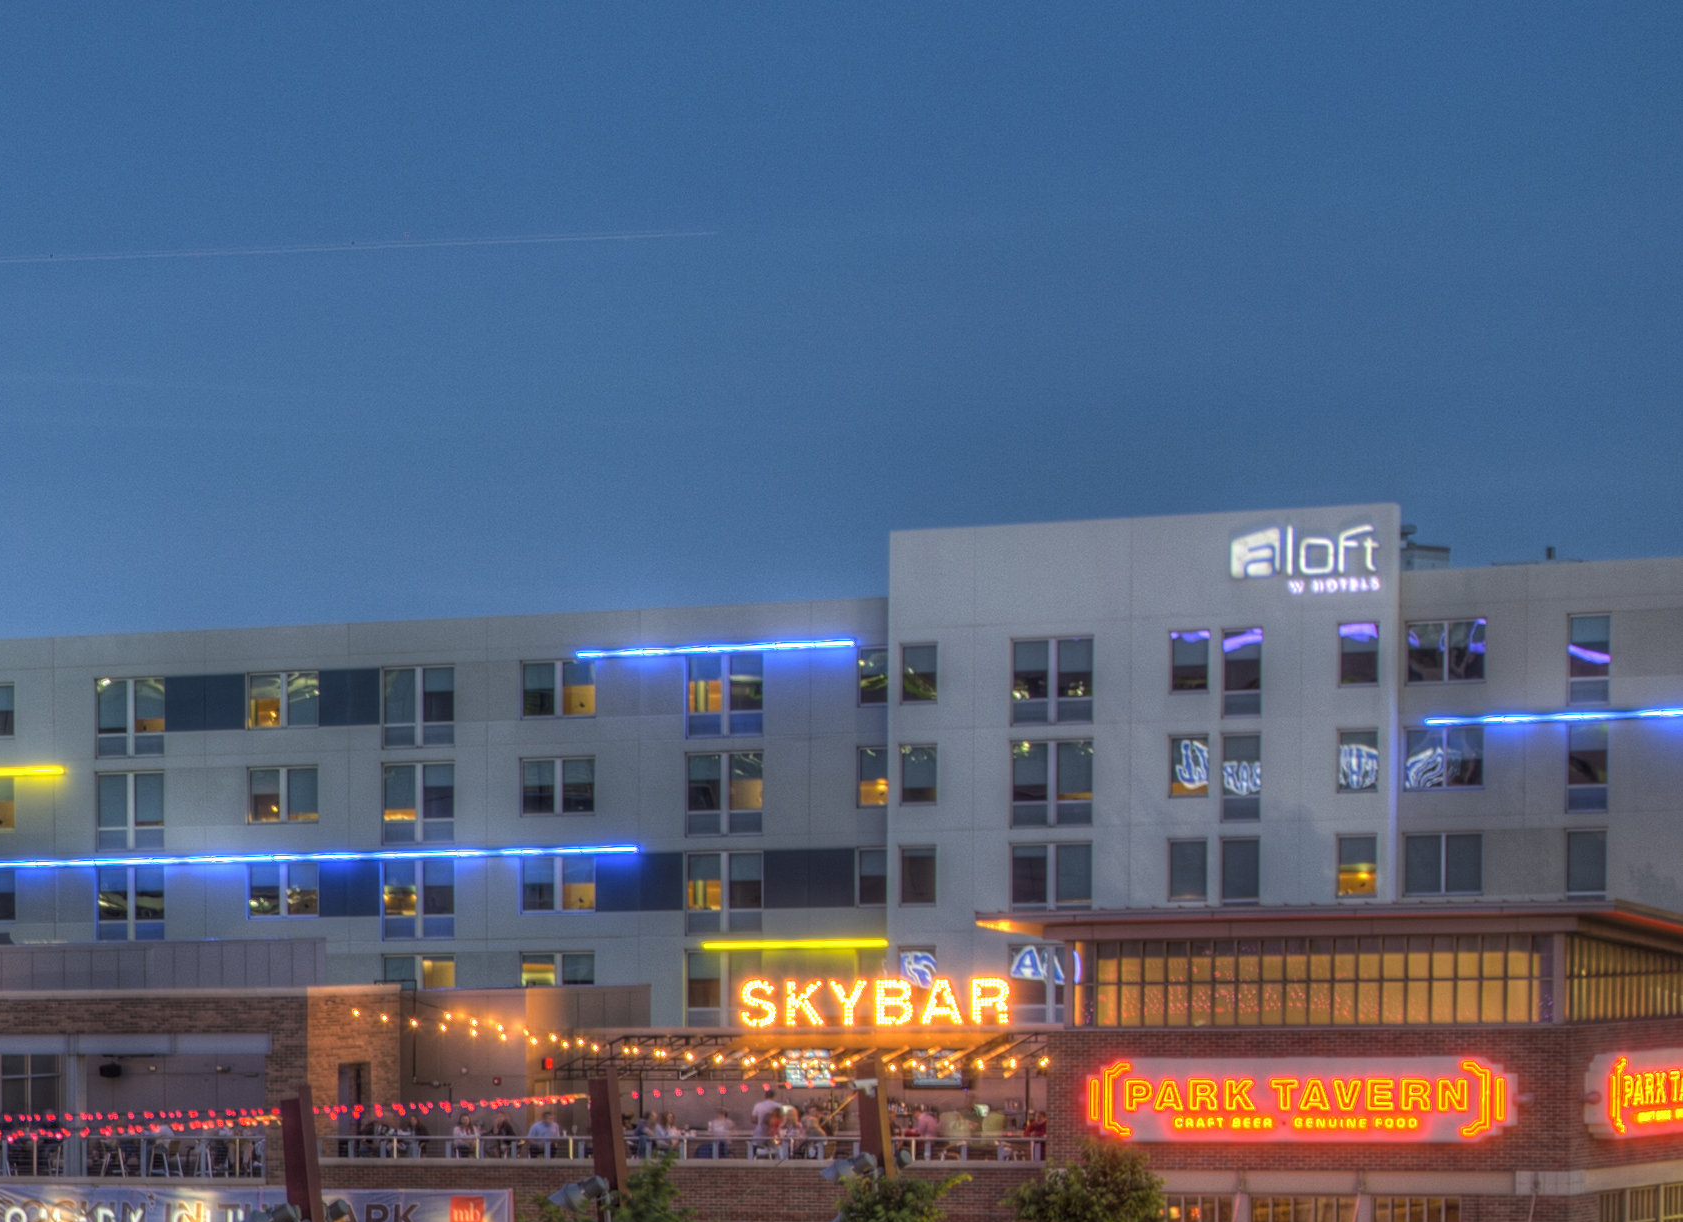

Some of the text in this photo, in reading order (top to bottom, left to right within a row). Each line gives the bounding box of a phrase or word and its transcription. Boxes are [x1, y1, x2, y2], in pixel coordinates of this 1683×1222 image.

[1231, 524, 1380, 579] aloft
[740, 977, 1011, 1028] SKYBAR
[1124, 1078, 1469, 1111] PARK TAVERN
[1623, 1072, 1667, 1108] PARK
[1174, 1116, 1419, 1129] CRAFT BEER GENUINE FOOD
